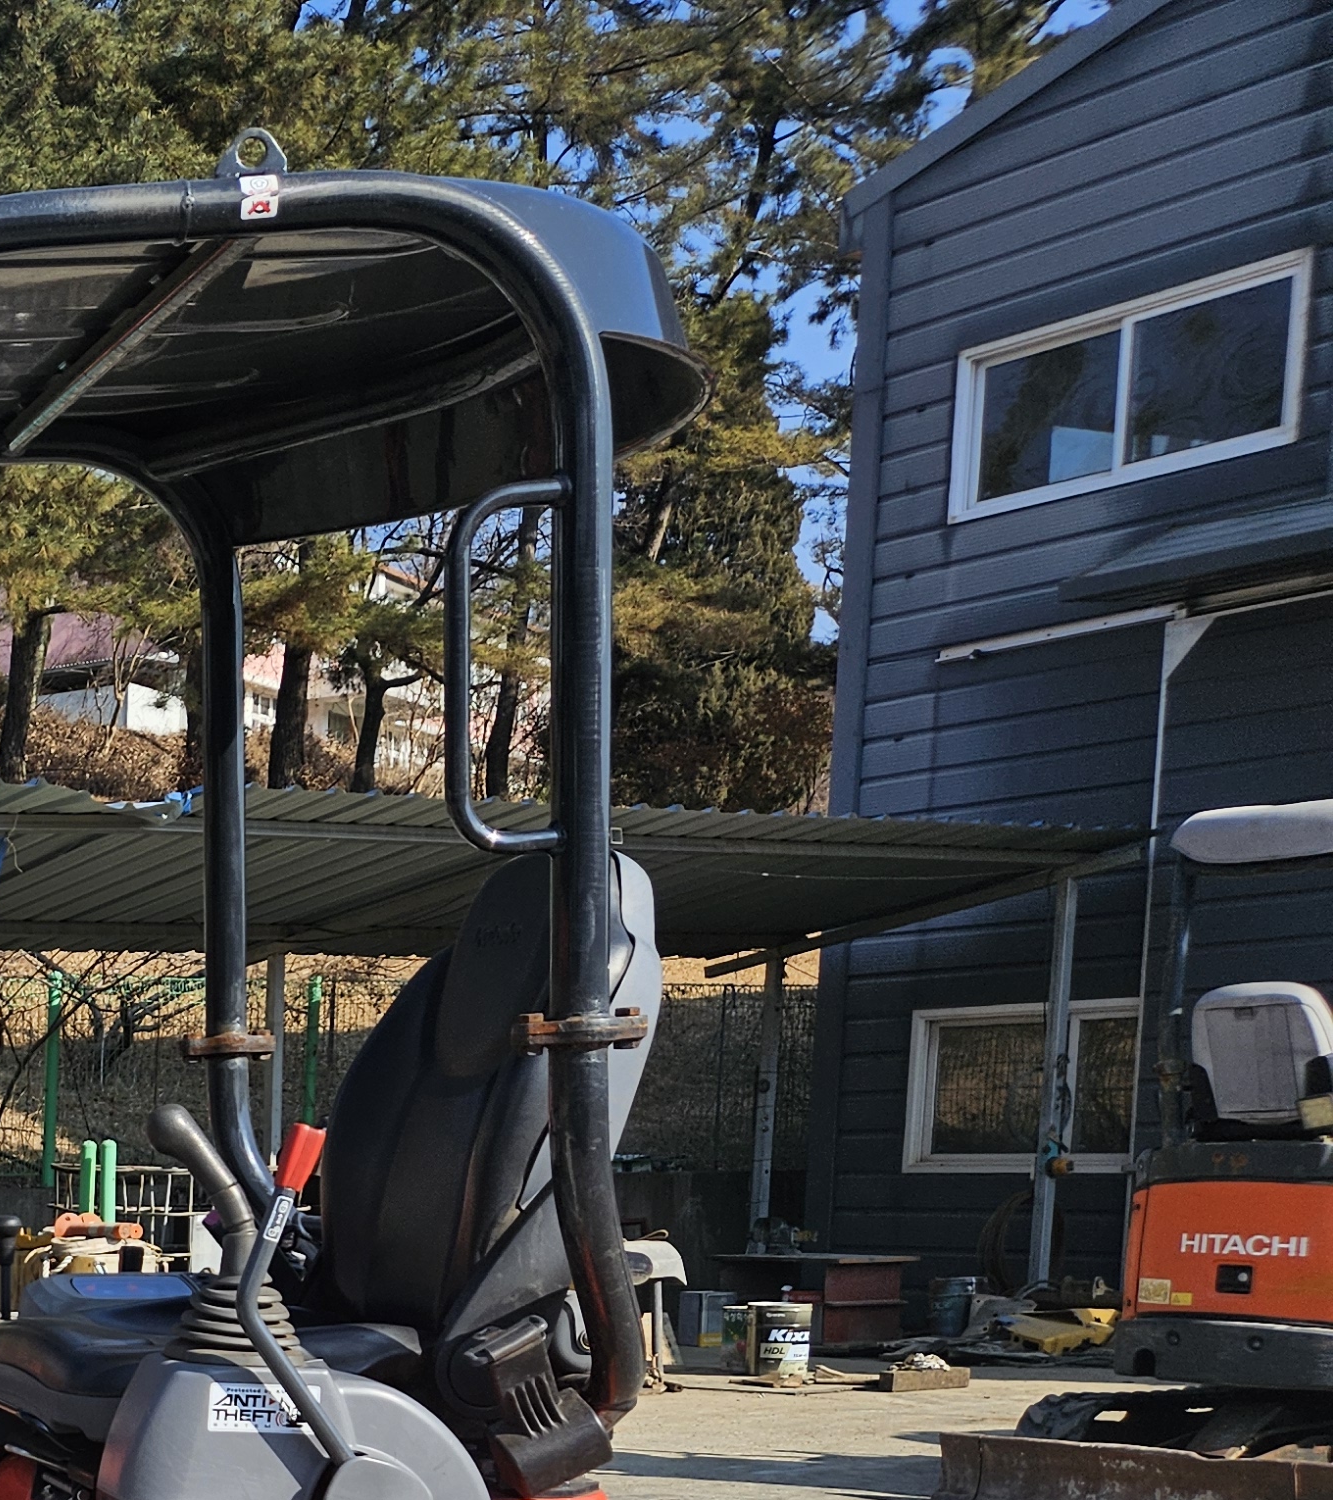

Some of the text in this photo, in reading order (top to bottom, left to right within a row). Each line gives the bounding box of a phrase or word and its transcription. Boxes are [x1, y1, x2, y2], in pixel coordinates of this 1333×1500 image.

[1180, 1233, 1309, 1257] HITACHI
[763, 1346, 786, 1355] HDL
[214, 1393, 266, 1408] ANTI
[212, 1409, 276, 1422] THEFT
